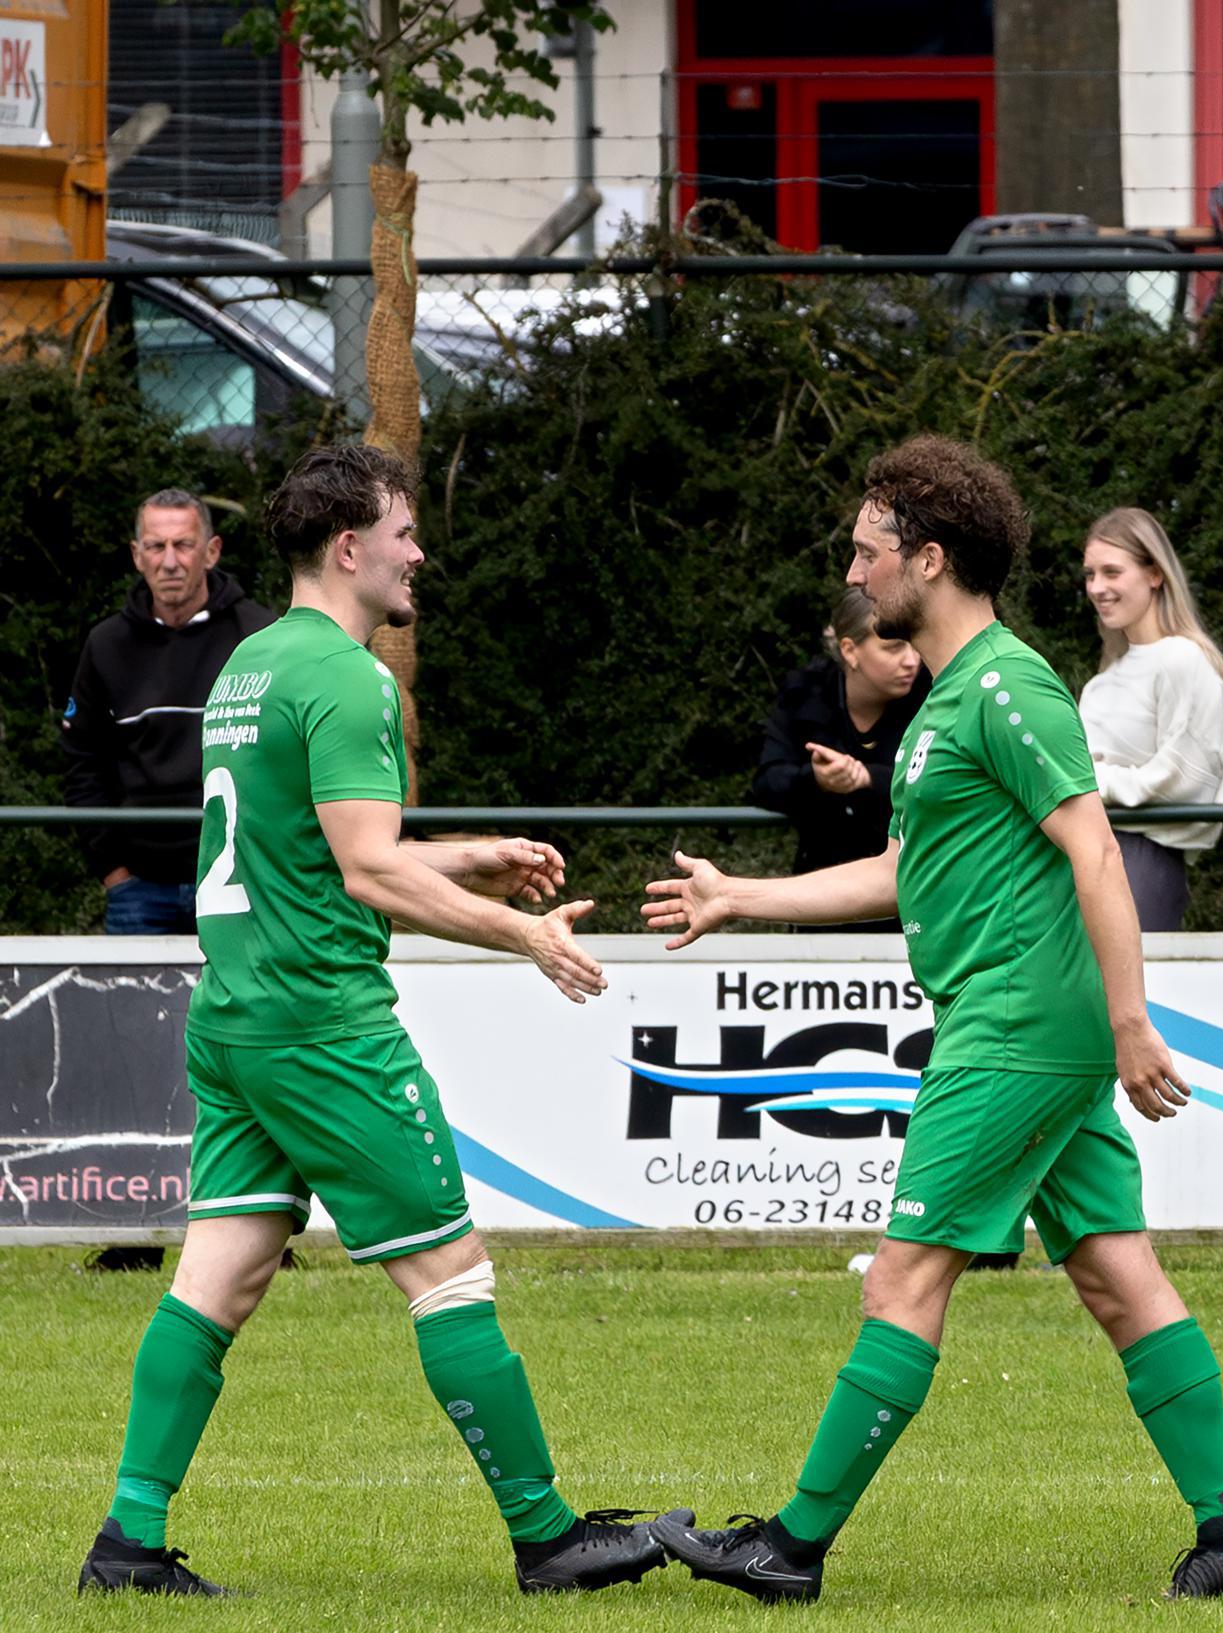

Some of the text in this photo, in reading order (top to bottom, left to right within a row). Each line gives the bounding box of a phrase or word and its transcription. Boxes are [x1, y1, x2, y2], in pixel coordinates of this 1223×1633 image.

[0, 38, 31, 98] PK
[196, 767, 251, 918] 2
[716, 971, 923, 1010] Hermans
[694, 1199, 893, 1224] 06-23148
